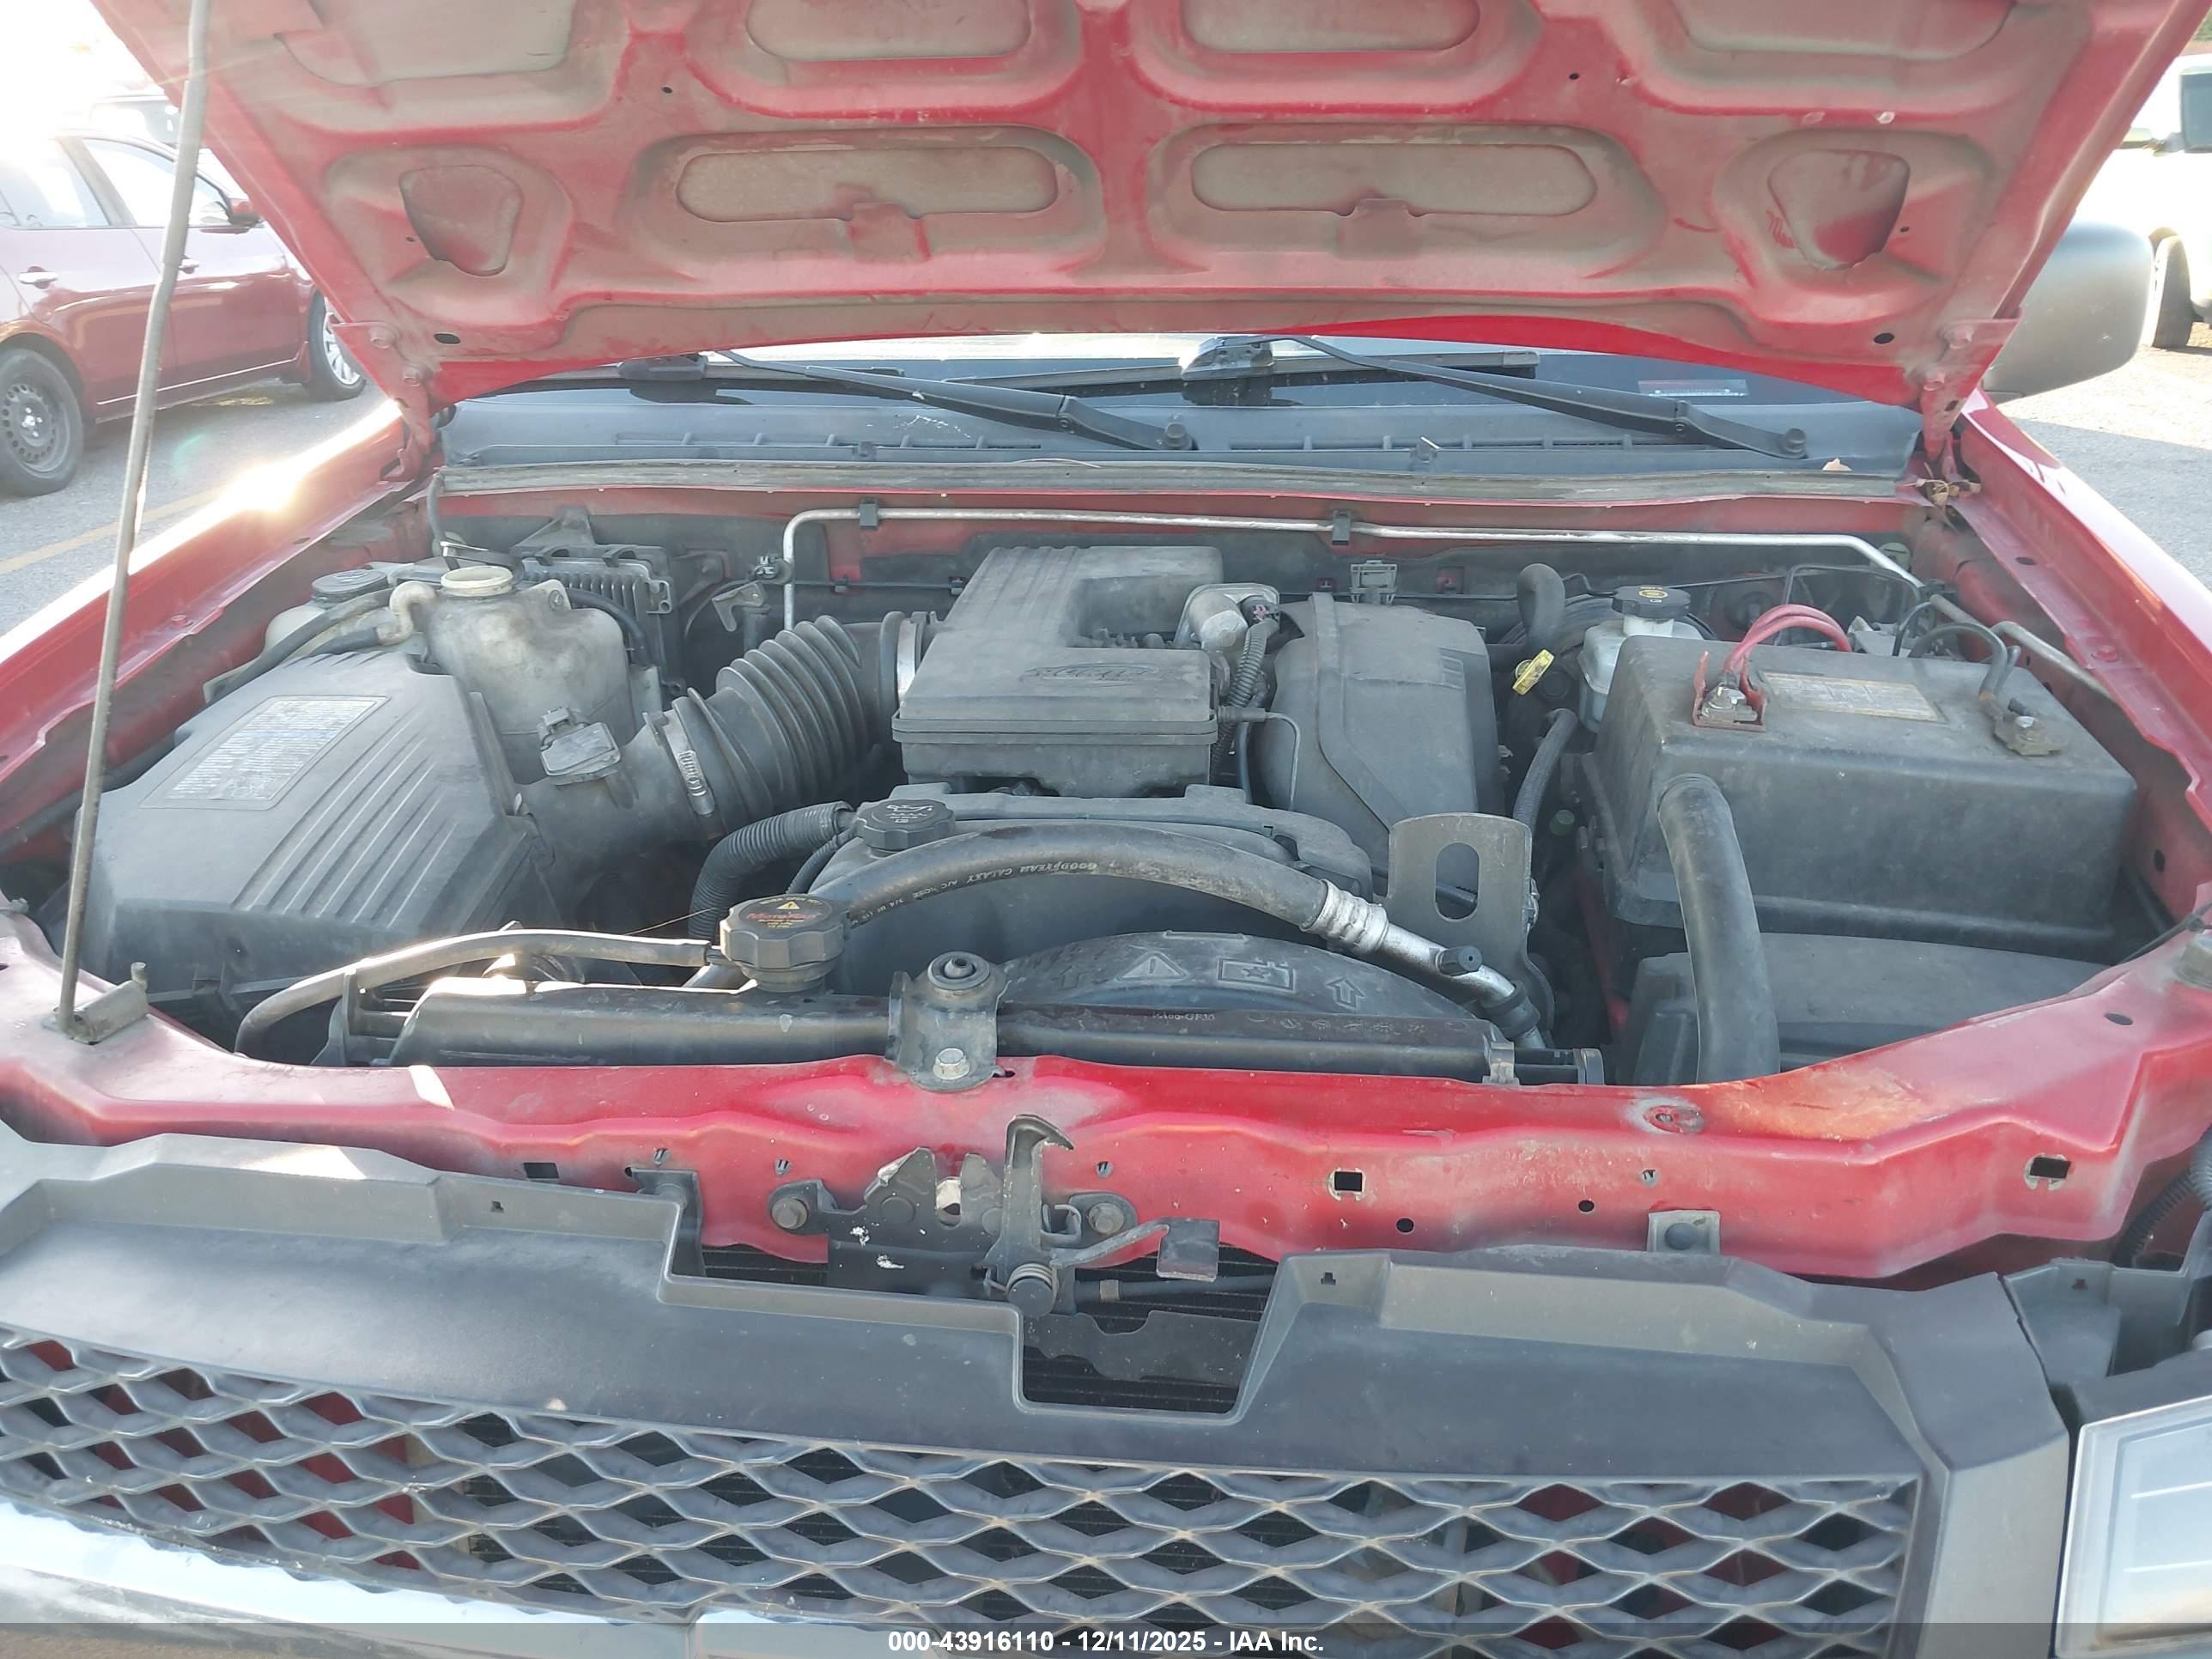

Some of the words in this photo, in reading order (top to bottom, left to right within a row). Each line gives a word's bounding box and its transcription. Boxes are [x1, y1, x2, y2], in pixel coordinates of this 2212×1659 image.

[1019, 860, 1098, 875] GOODYEAR
[966, 867, 1013, 884] GALAXY
[940, 878, 958, 890] A/C
